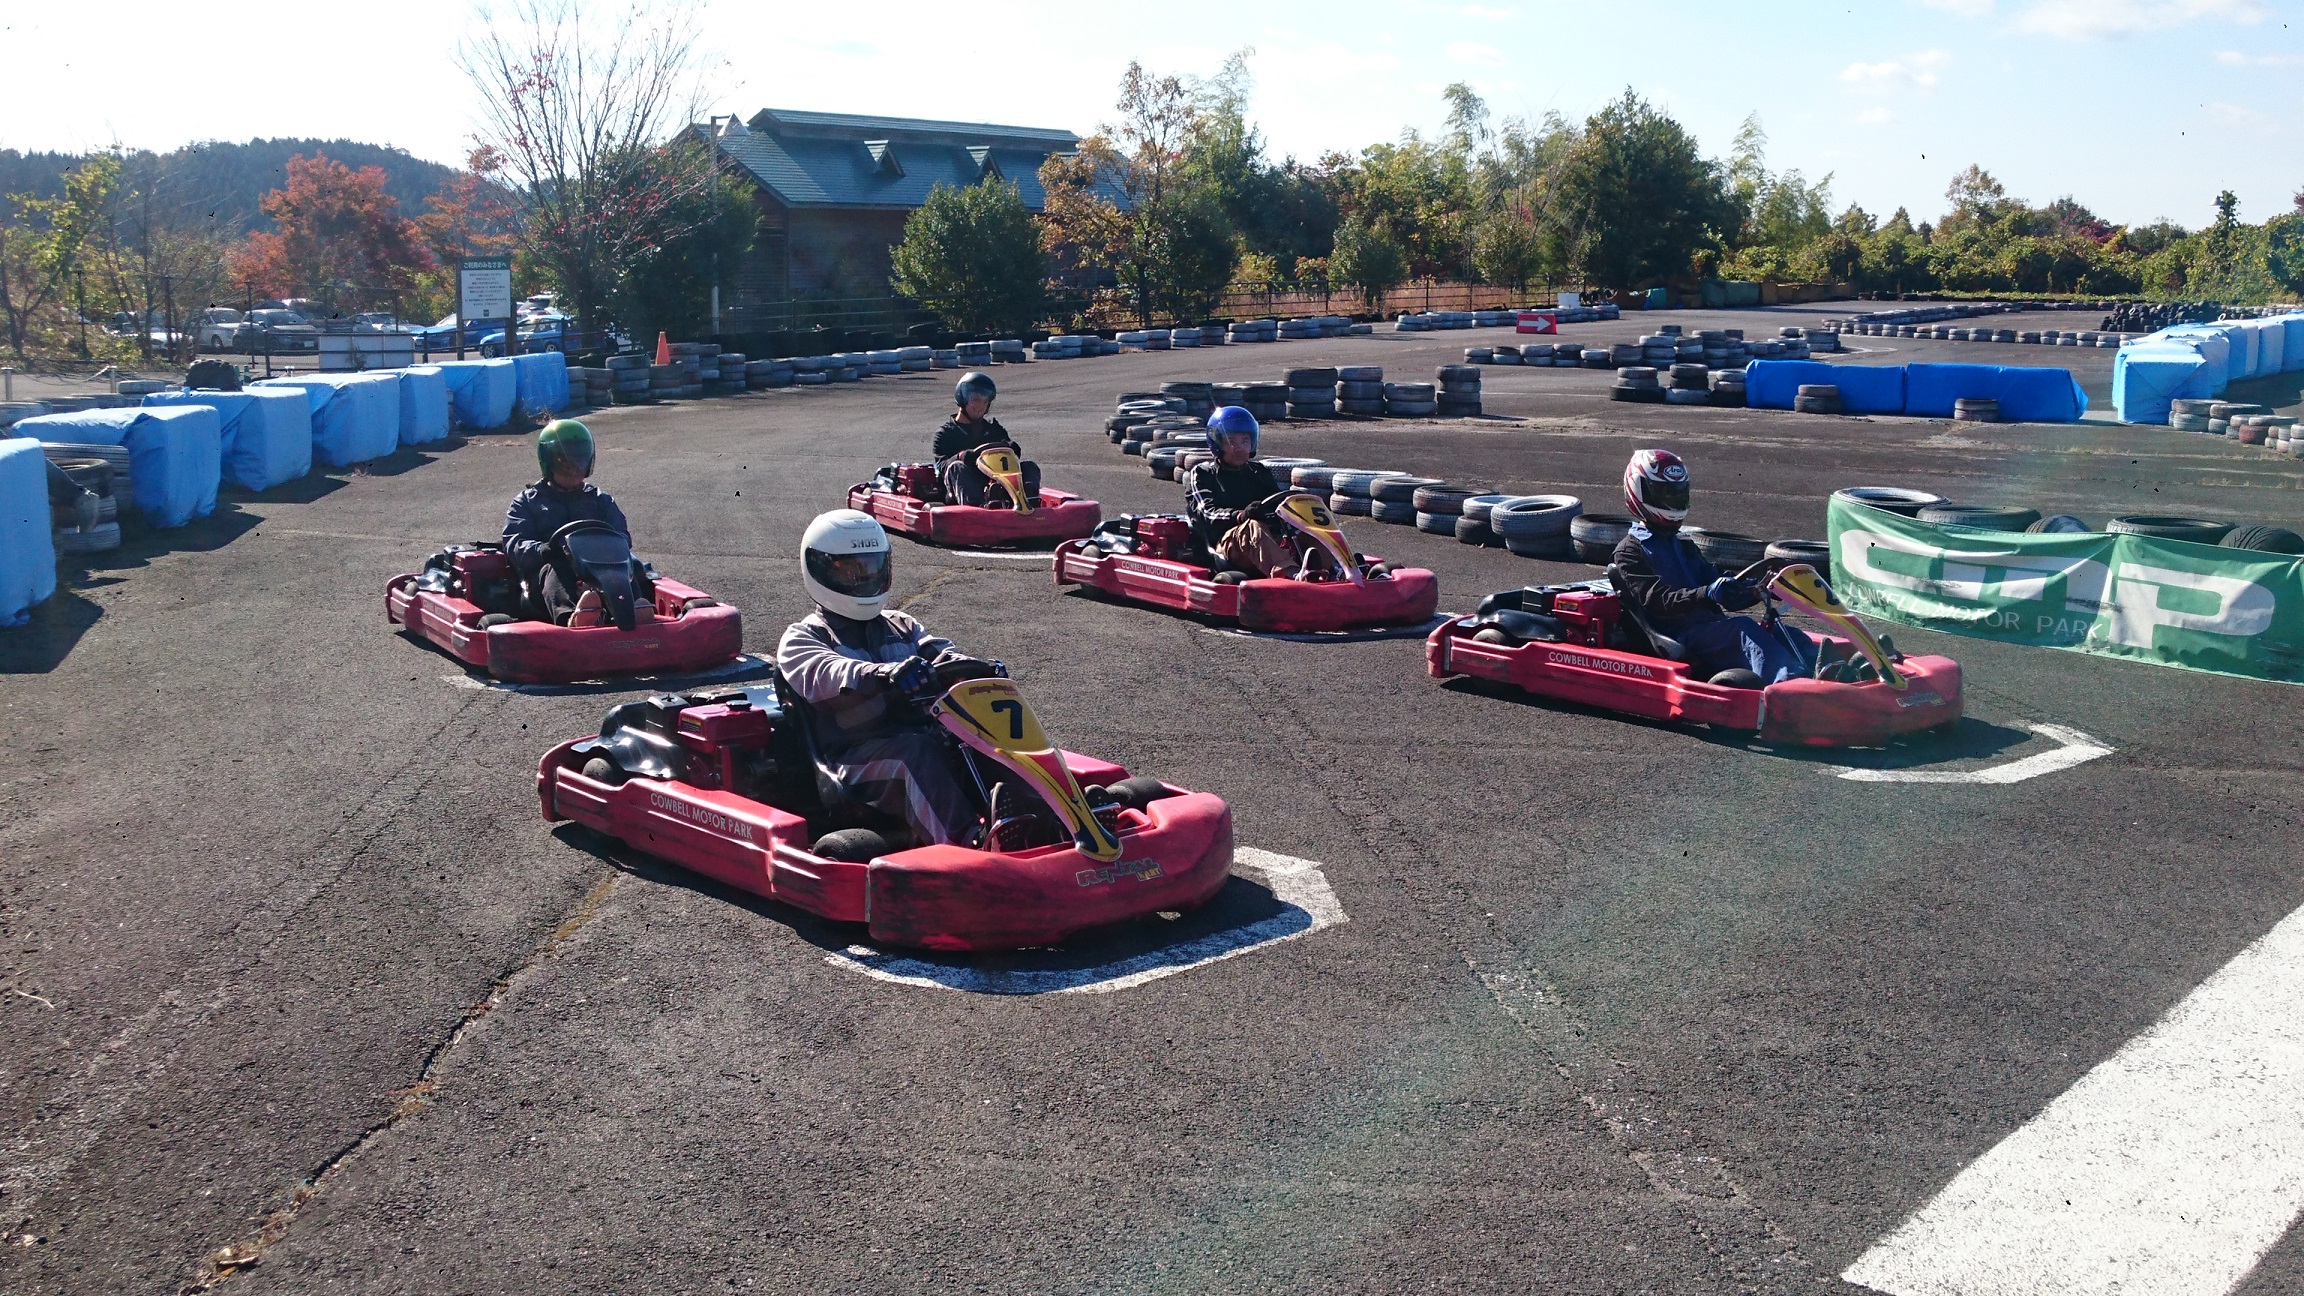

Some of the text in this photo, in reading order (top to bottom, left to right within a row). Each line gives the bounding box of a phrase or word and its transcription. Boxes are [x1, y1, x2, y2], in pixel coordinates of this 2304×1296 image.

[1000, 456, 1009, 471] 1
[1311, 507, 1331, 526] 5
[851, 538, 880, 549] SHOEI
[1813, 578, 1840, 605] 2
[2037, 615, 2103, 638] PARK
[1548, 651, 1591, 667] COWBELL
[1592, 658, 1626, 673] MOTOR
[991, 699, 1023, 739] 7
[650, 792, 753, 840] COWBELL MOTOR PARK
